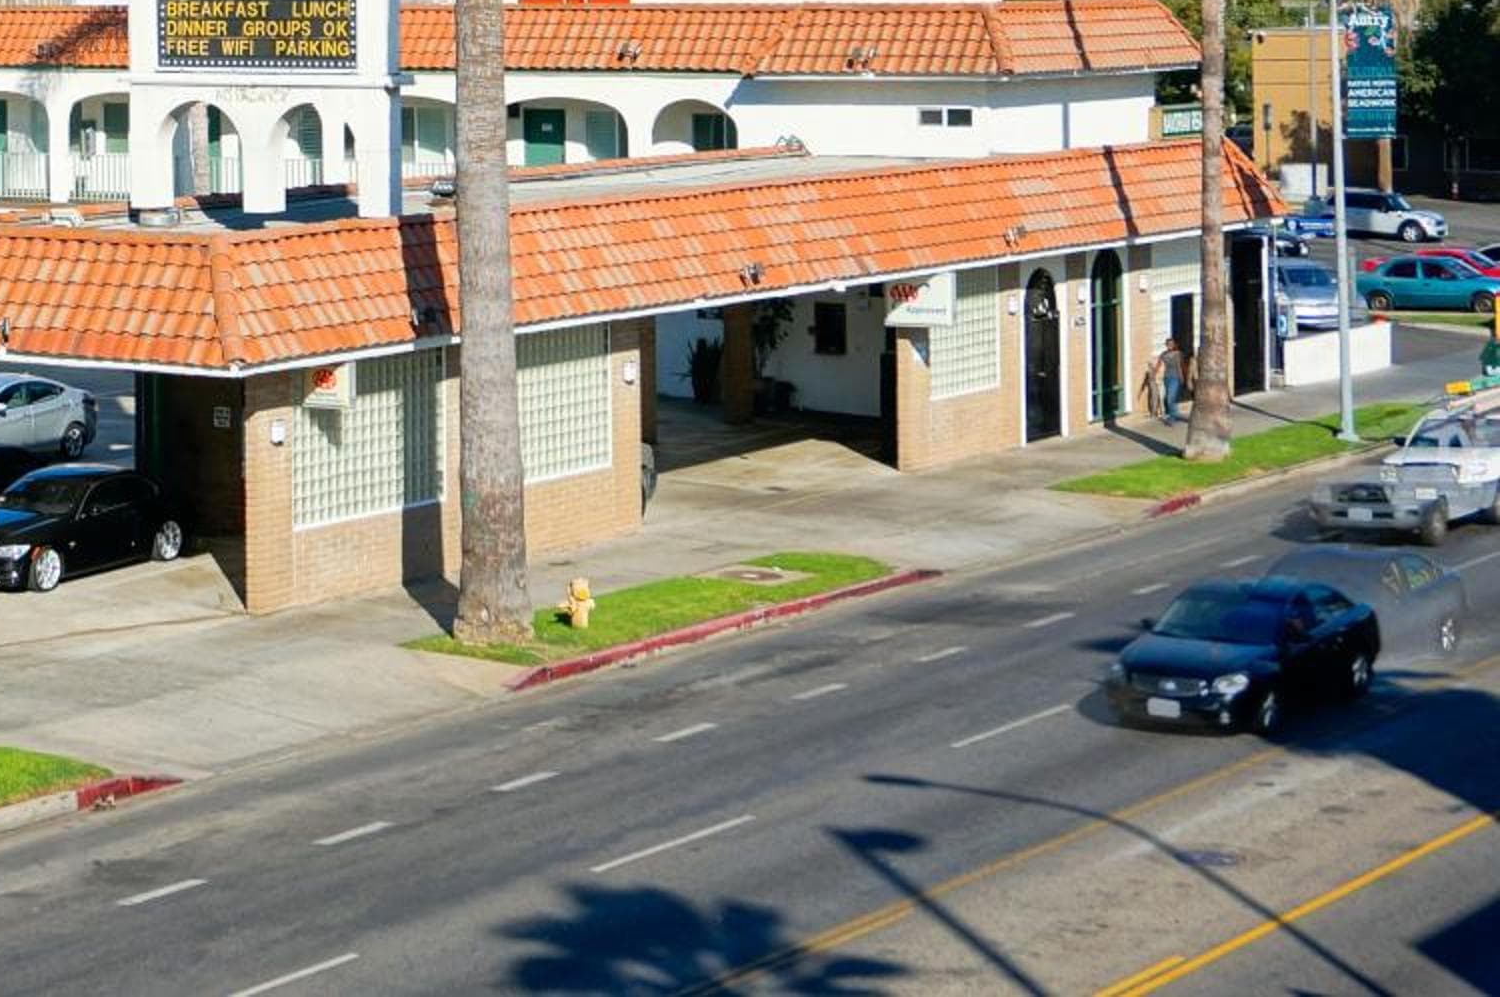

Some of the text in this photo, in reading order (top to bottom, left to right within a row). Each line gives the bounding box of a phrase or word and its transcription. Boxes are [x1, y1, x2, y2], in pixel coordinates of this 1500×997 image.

[167, 0, 349, 18] BREAKFAST LUNCH
[167, 20, 348, 37] DINNER GROUPS OK
[166, 39, 349, 56] FREE WIFI PARKING
